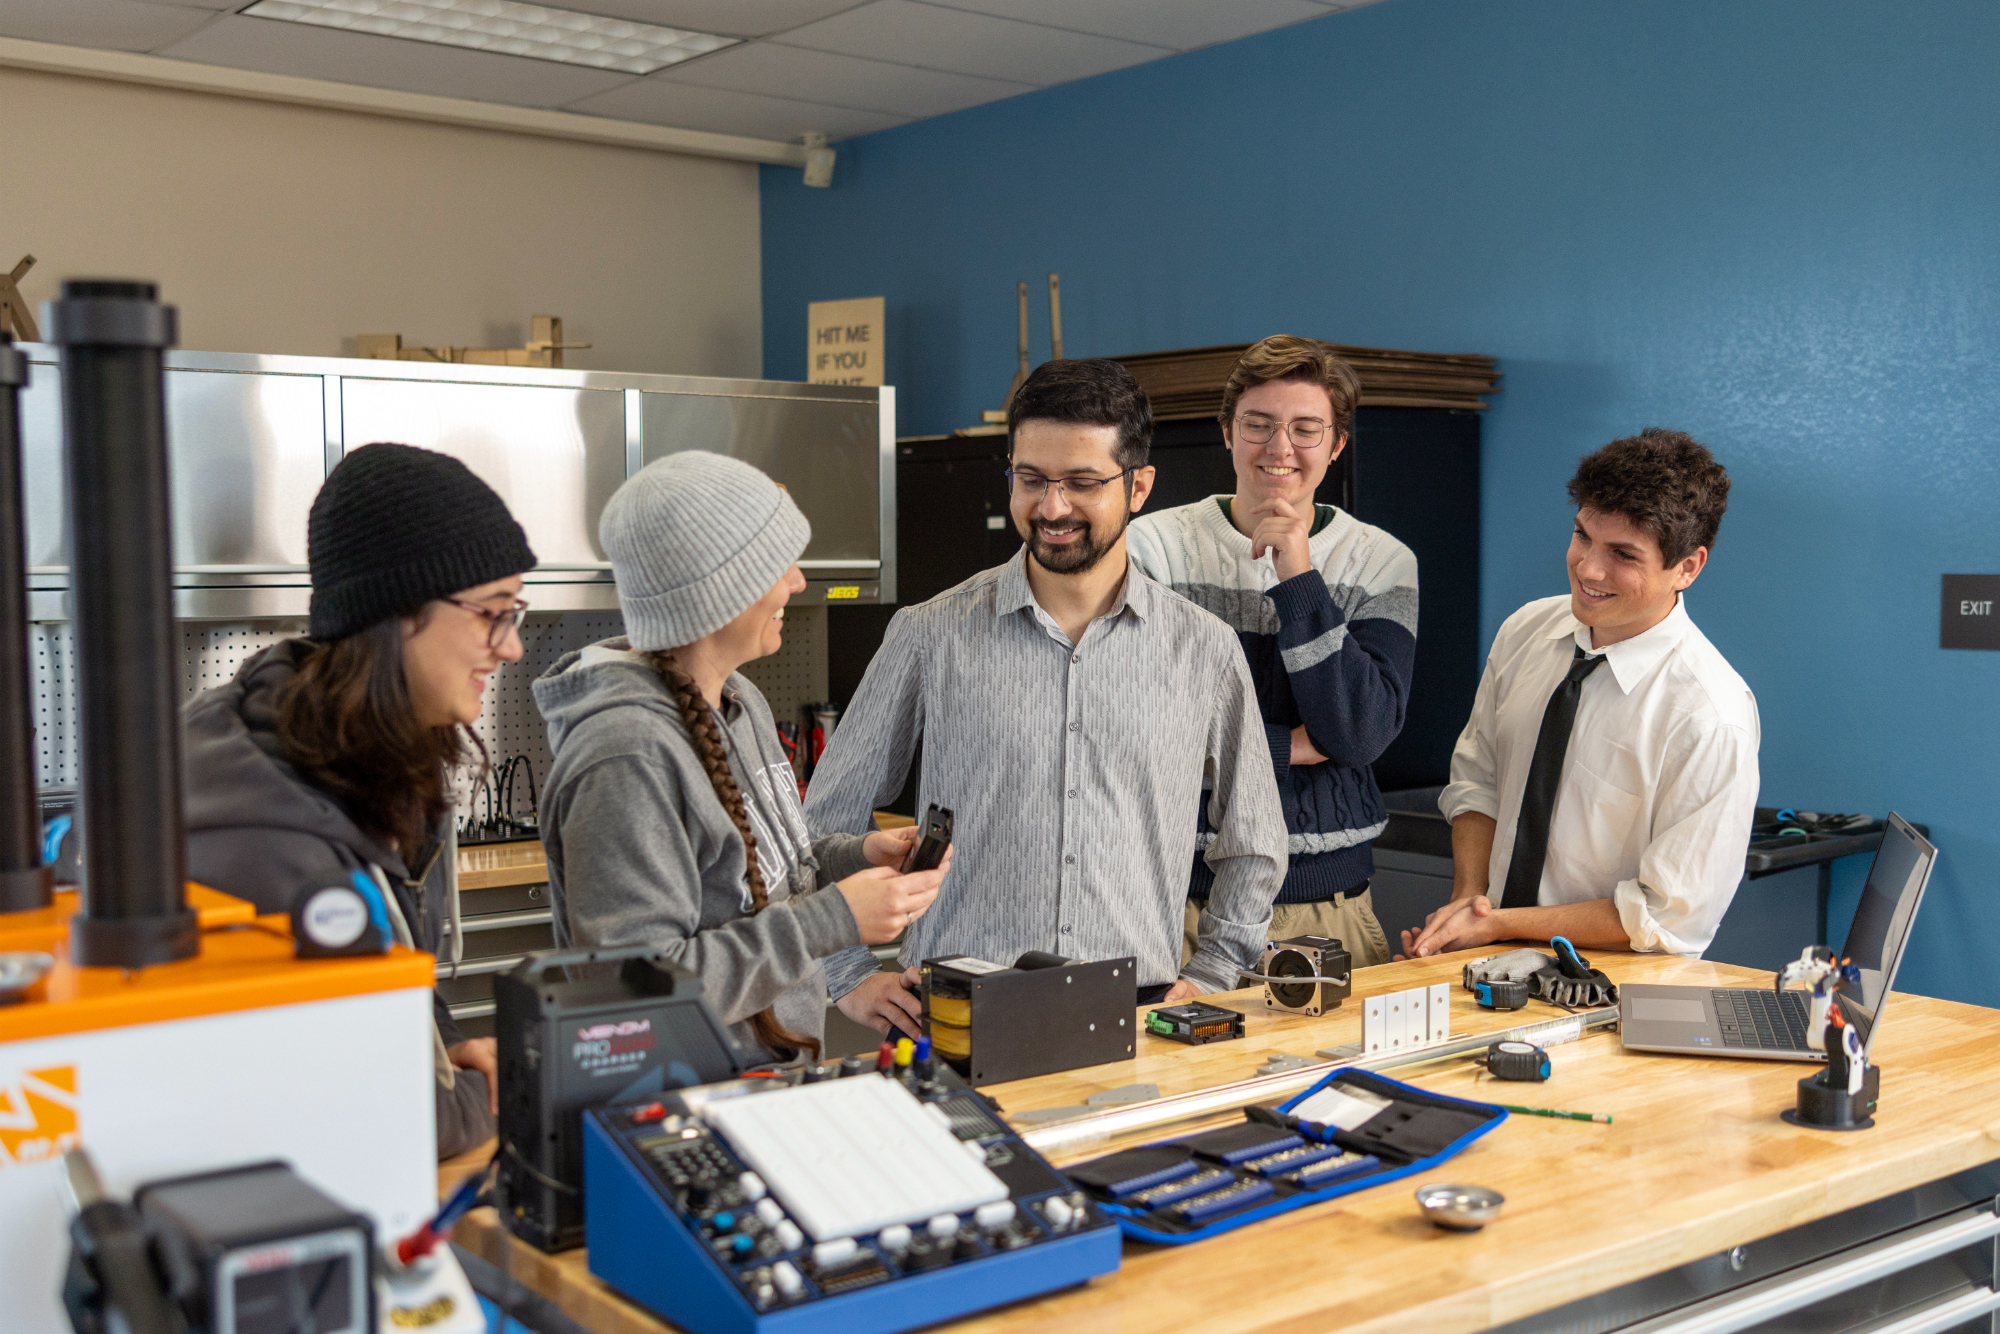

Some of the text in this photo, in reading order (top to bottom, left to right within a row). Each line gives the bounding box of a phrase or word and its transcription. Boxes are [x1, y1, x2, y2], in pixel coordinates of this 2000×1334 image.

[816, 324, 870, 345] HIT ME
[816, 350, 867, 371] IF YOU
[826, 586, 860, 599] JEGS
[1960, 600, 1993, 616] EXIT
